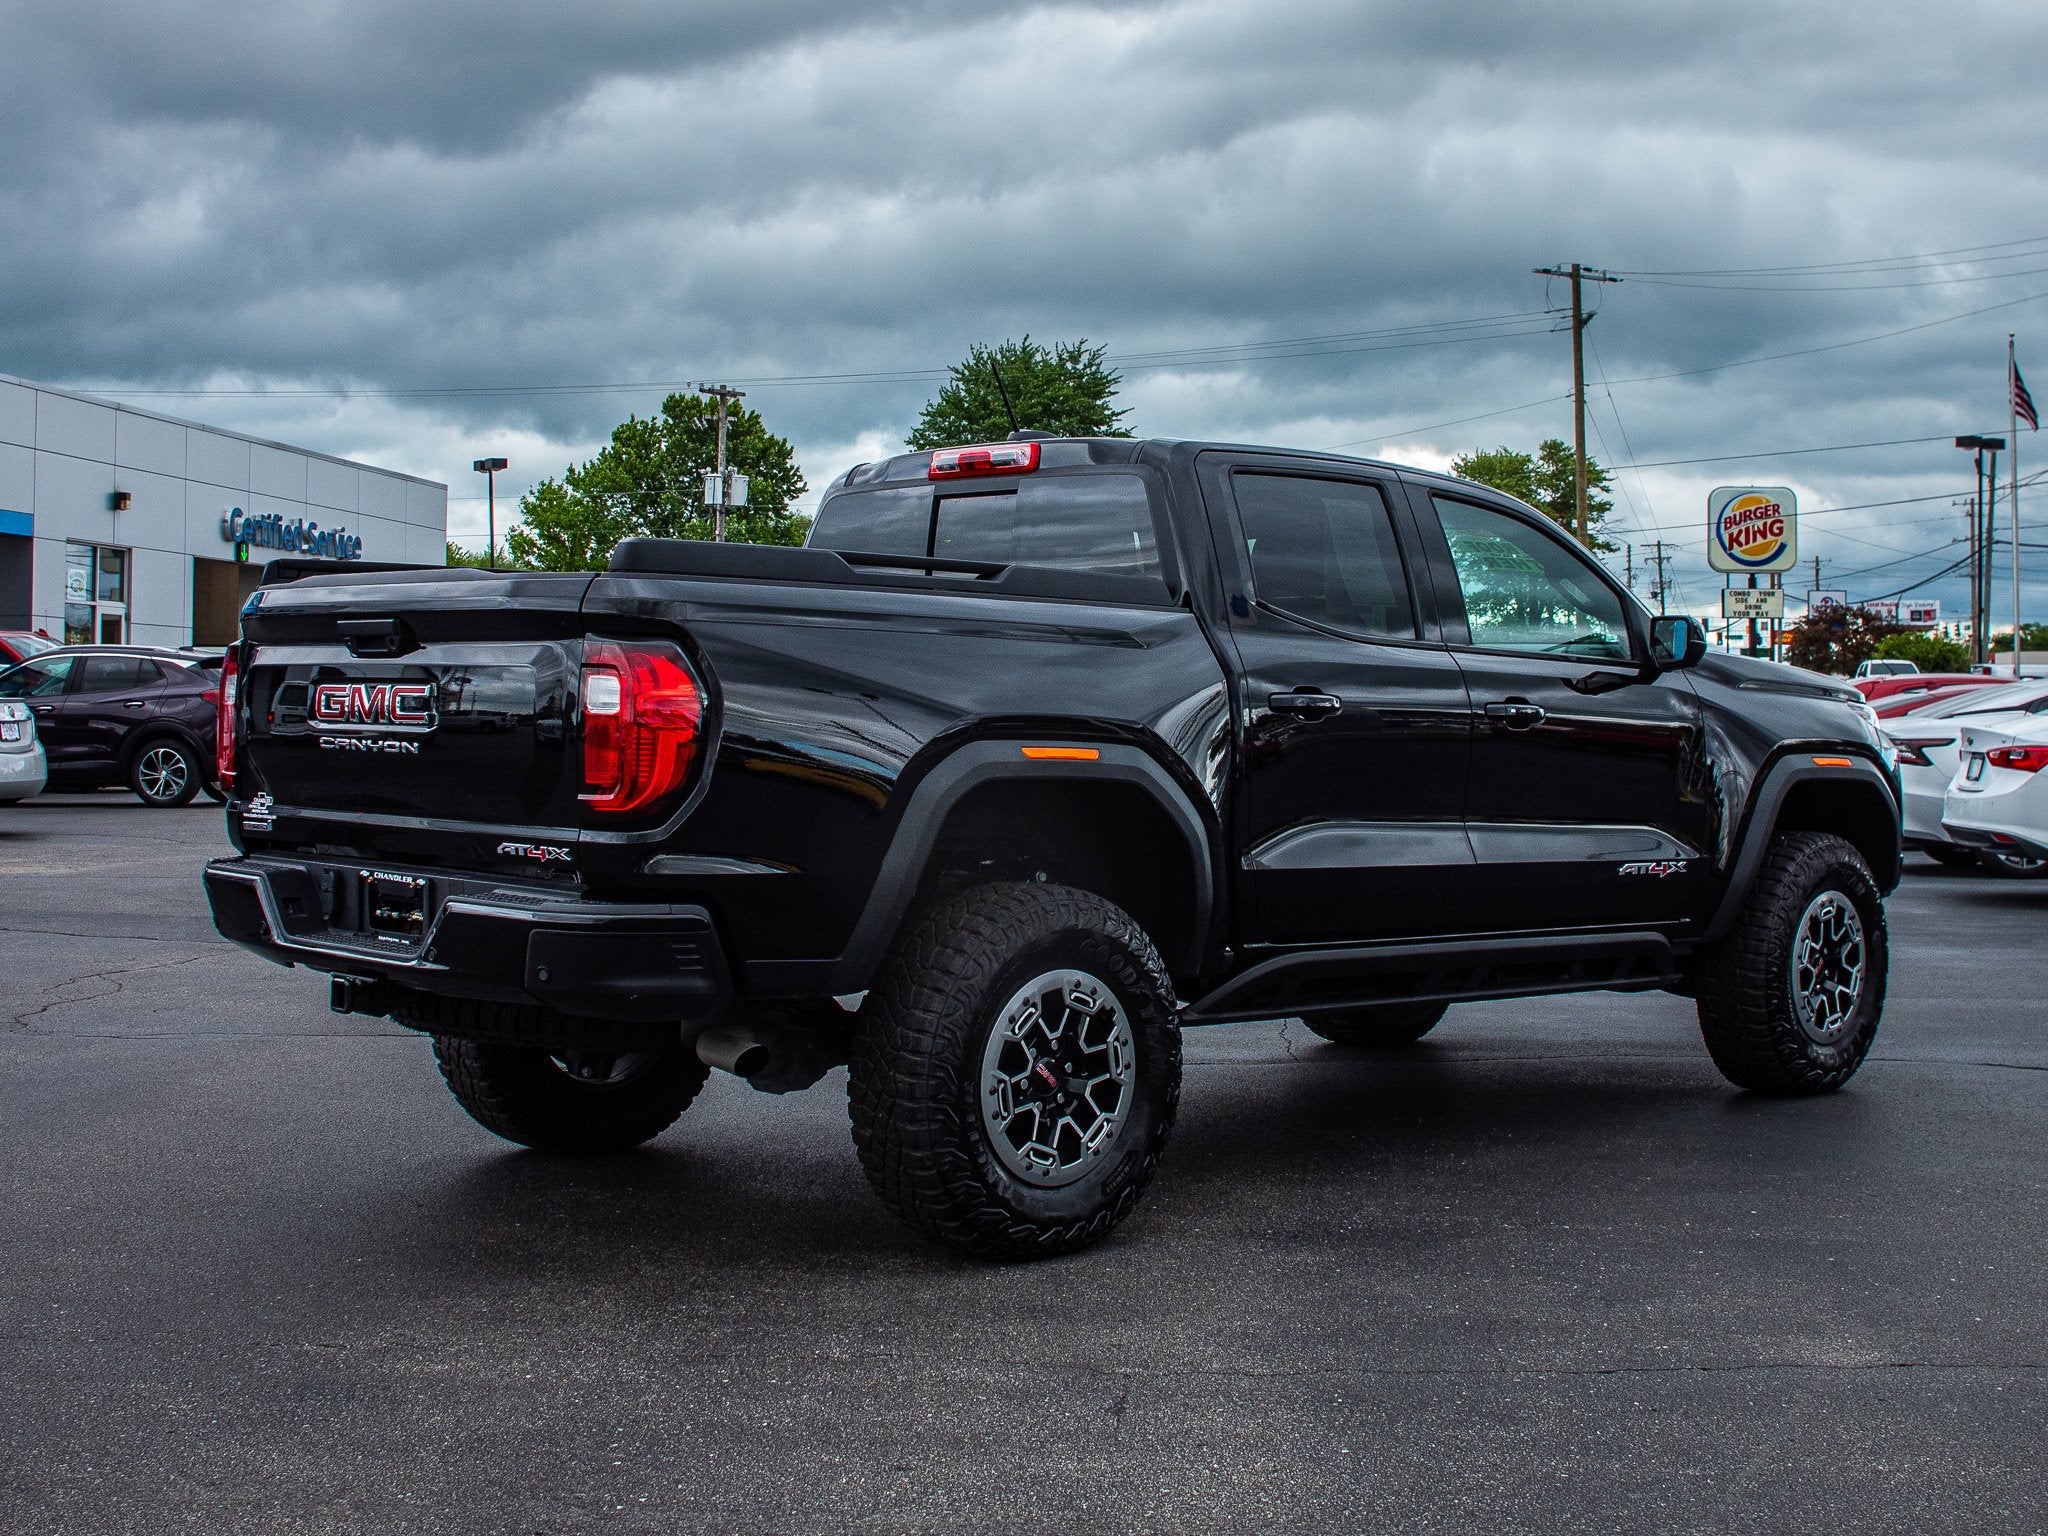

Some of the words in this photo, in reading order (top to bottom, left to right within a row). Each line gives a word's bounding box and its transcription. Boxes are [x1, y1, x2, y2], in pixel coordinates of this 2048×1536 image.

[1723, 503, 1781, 532] BURGER
[229, 507, 303, 551] Certified
[307, 521, 363, 560] Service
[1727, 518, 1785, 552] KING
[315, 684, 431, 723] GMC
[319, 736, 419, 754] CANYON
[497, 842, 572, 862] AT4X
[373, 871, 413, 884] CHANDLER
[1618, 861, 1687, 878] AT4X
